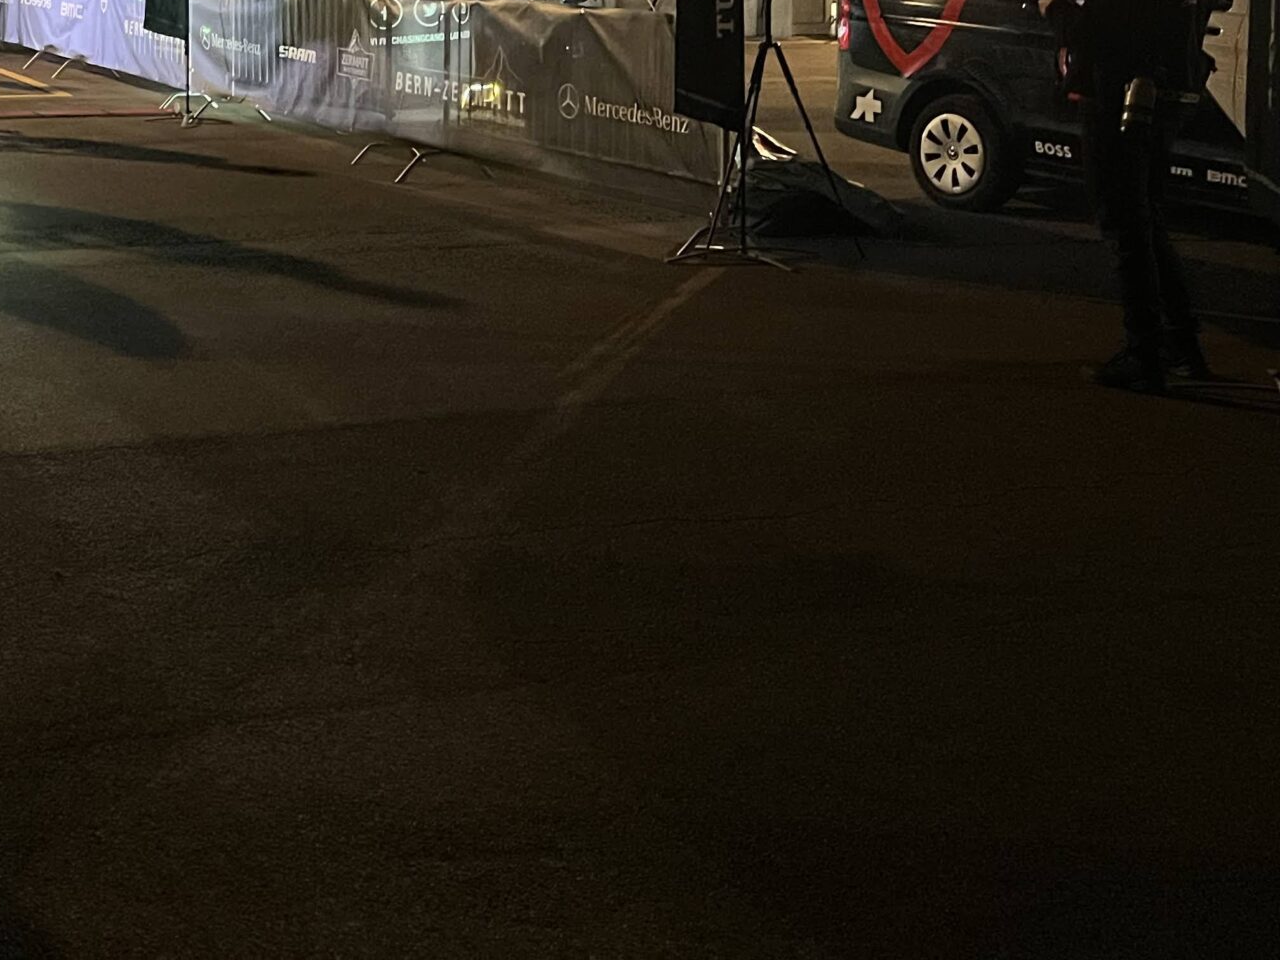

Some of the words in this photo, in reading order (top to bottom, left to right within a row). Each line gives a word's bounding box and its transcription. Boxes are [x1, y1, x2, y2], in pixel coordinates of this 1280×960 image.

[279, 45, 317, 64] SRAM
[584, 95, 689, 134] Mercedes-Benz
[1034, 140, 1072, 159] BOSS
